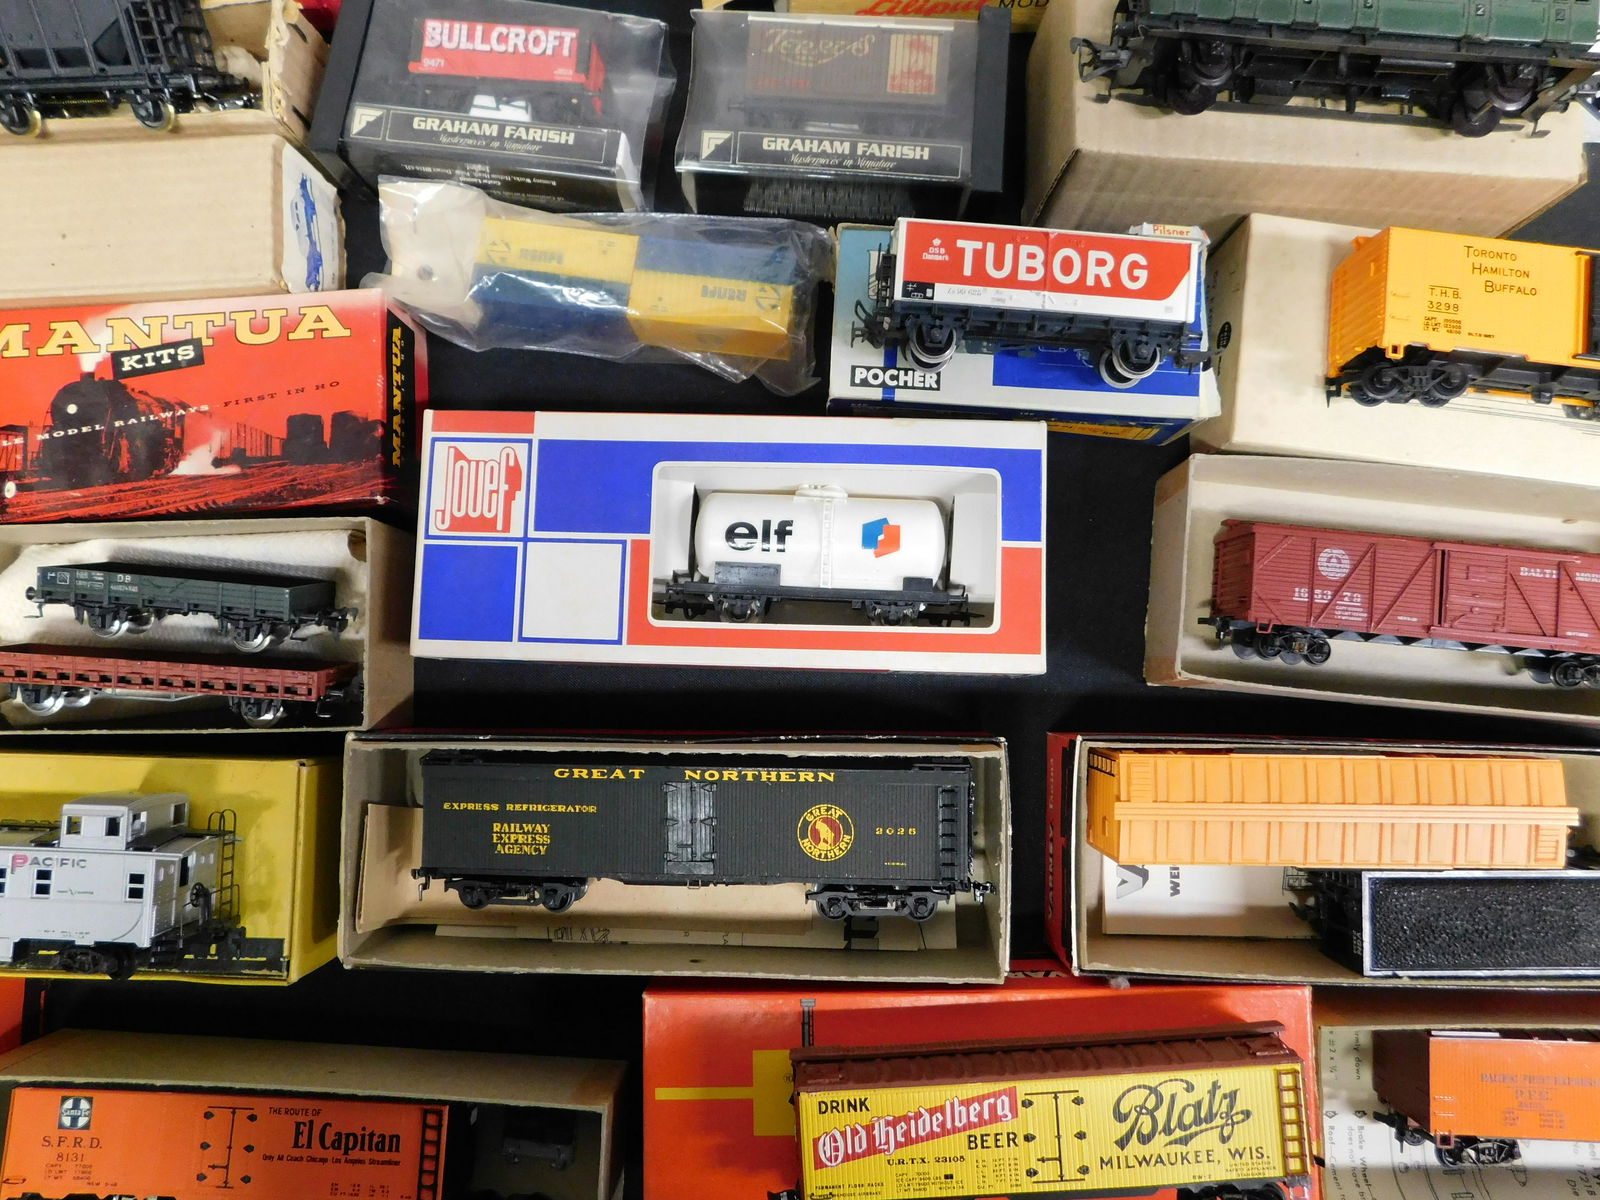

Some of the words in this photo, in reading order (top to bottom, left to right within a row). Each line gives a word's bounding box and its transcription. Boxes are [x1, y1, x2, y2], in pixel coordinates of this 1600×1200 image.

[1475, 3, 1485, 16] 2
[425, 20, 577, 57] BULLCROFT
[412, 116, 497, 137] GRAHAM
[504, 126, 575, 145] FARISH
[762, 136, 850, 156] GRAHAM
[857, 142, 930, 160] FARISH
[1153, 224, 1191, 236] Pilsner
[1464, 245, 1517, 261] TORONTO
[956, 239, 1149, 289] TUBORG
[1472, 262, 1530, 279] HAMILTON
[1484, 280, 1537, 296] BUFFALO
[1427, 301, 1459, 312] 3298
[121, 344, 195, 372] KITS
[853, 366, 938, 389] POCHER
[392, 327, 402, 466] MANTUA
[36, 424, 104, 440] MODEL
[114, 404, 210, 428] RAILWAYS
[223, 392, 277, 408] FIRST
[287, 387, 305, 397] IN
[315, 381, 340, 391] HO
[434, 446, 519, 531] Jouef
[725, 519, 794, 553] elf
[553, 768, 645, 780] GREAT
[684, 770, 835, 783] NORTHERN
[443, 802, 499, 812] EXPRESS
[506, 803, 597, 813] REFRIGERATOR
[805, 806, 843, 822] GREAT
[492, 823, 550, 834] RAILWAY
[492, 833, 550, 845] EXPRESS
[801, 834, 852, 859] NORTHERN
[495, 844, 547, 856] AGENCY
[11, 854, 87, 874] PACIFIC
[61, 1108, 81, 1116] Santa
[269, 1106, 283, 1115] THE
[284, 1107, 309, 1117] ROUTE
[312, 1108, 323, 1117] OF
[818, 1097, 870, 1115] DRINK
[1112, 1078, 1253, 1151] Blatz
[292, 1120, 314, 1150] El
[318, 1122, 401, 1156] Capitan
[817, 1122, 867, 1167] Old
[871, 1095, 1013, 1155] Heidelberg
[967, 1131, 1019, 1150] BEER
[57, 1152, 84, 1162] 8131
[1099, 1149, 1221, 1171] MILWAUKEE,
[1228, 1146, 1271, 1162] WIS.
